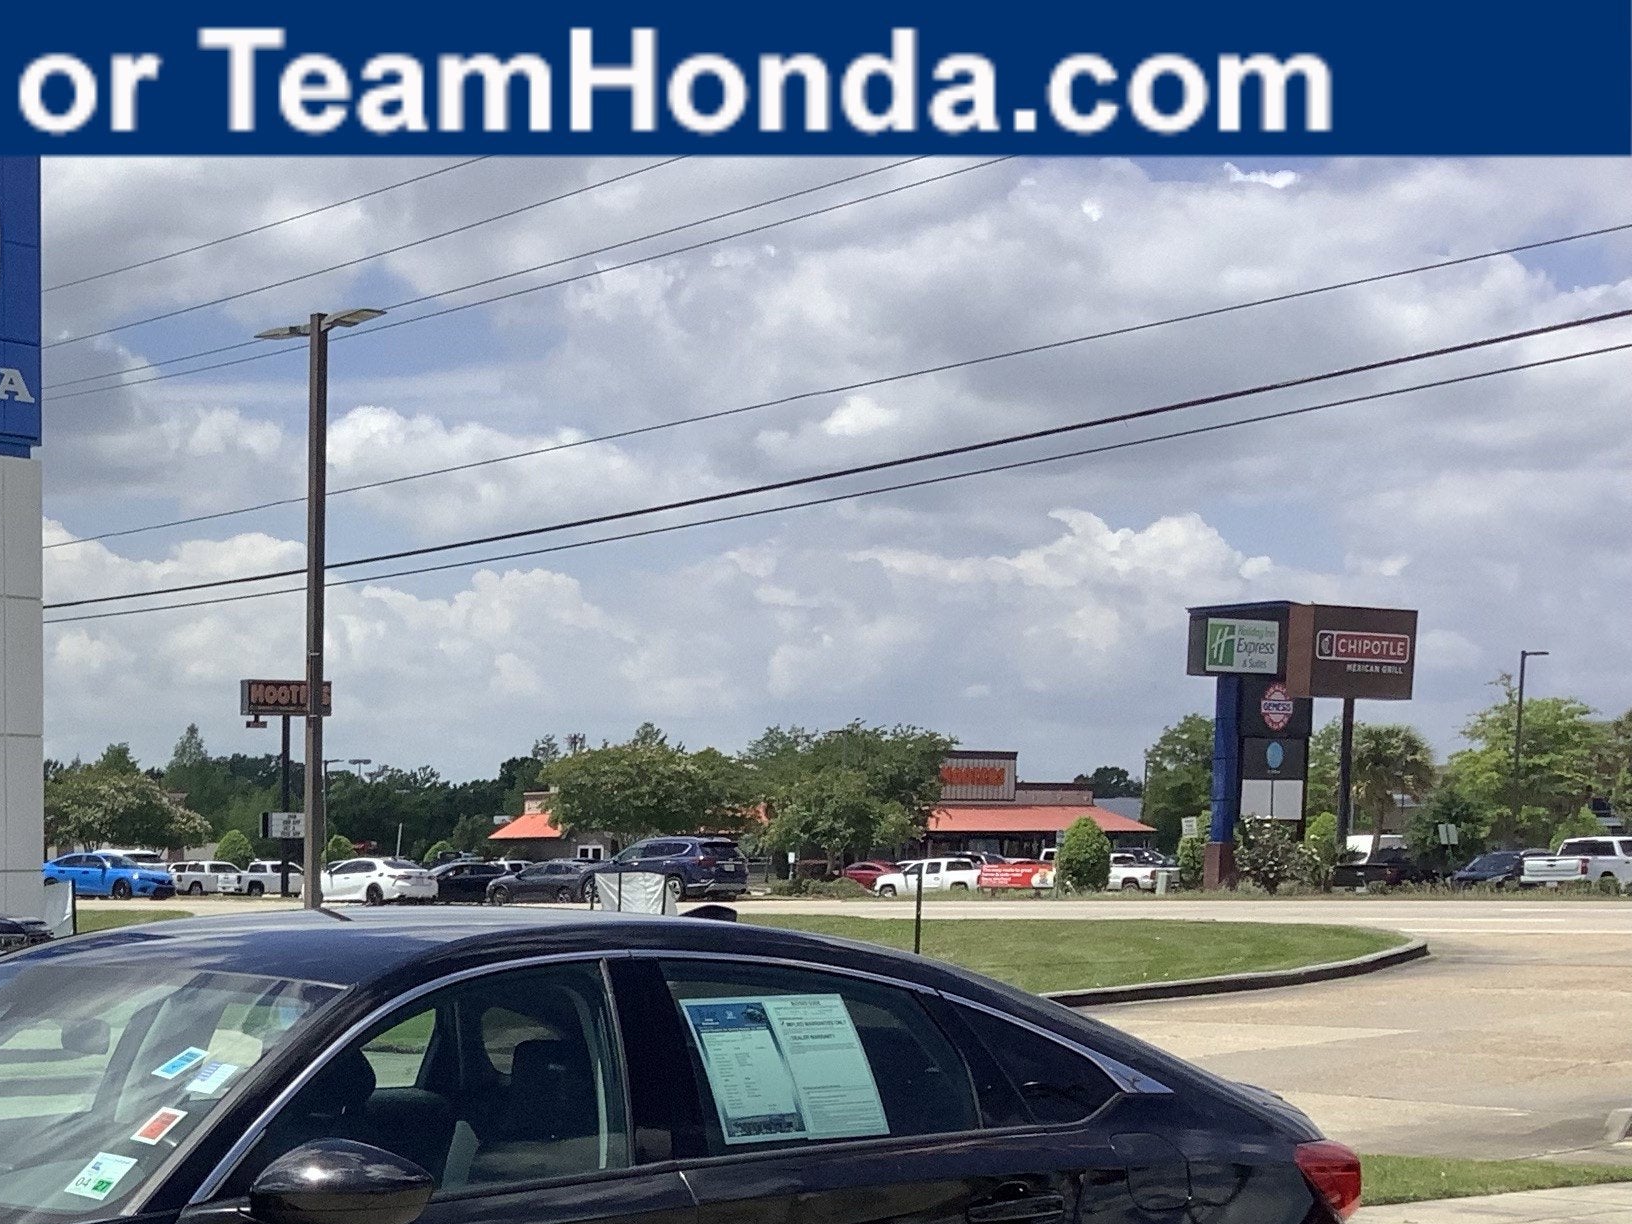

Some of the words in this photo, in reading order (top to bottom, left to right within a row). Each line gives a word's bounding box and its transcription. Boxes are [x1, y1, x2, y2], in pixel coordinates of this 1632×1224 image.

[1237, 637, 1276, 657] Express
[1337, 638, 1405, 656] CHIPOTLE
[1346, 664, 1380, 673] MEXICAN
[1381, 665, 1404, 675] GRILL
